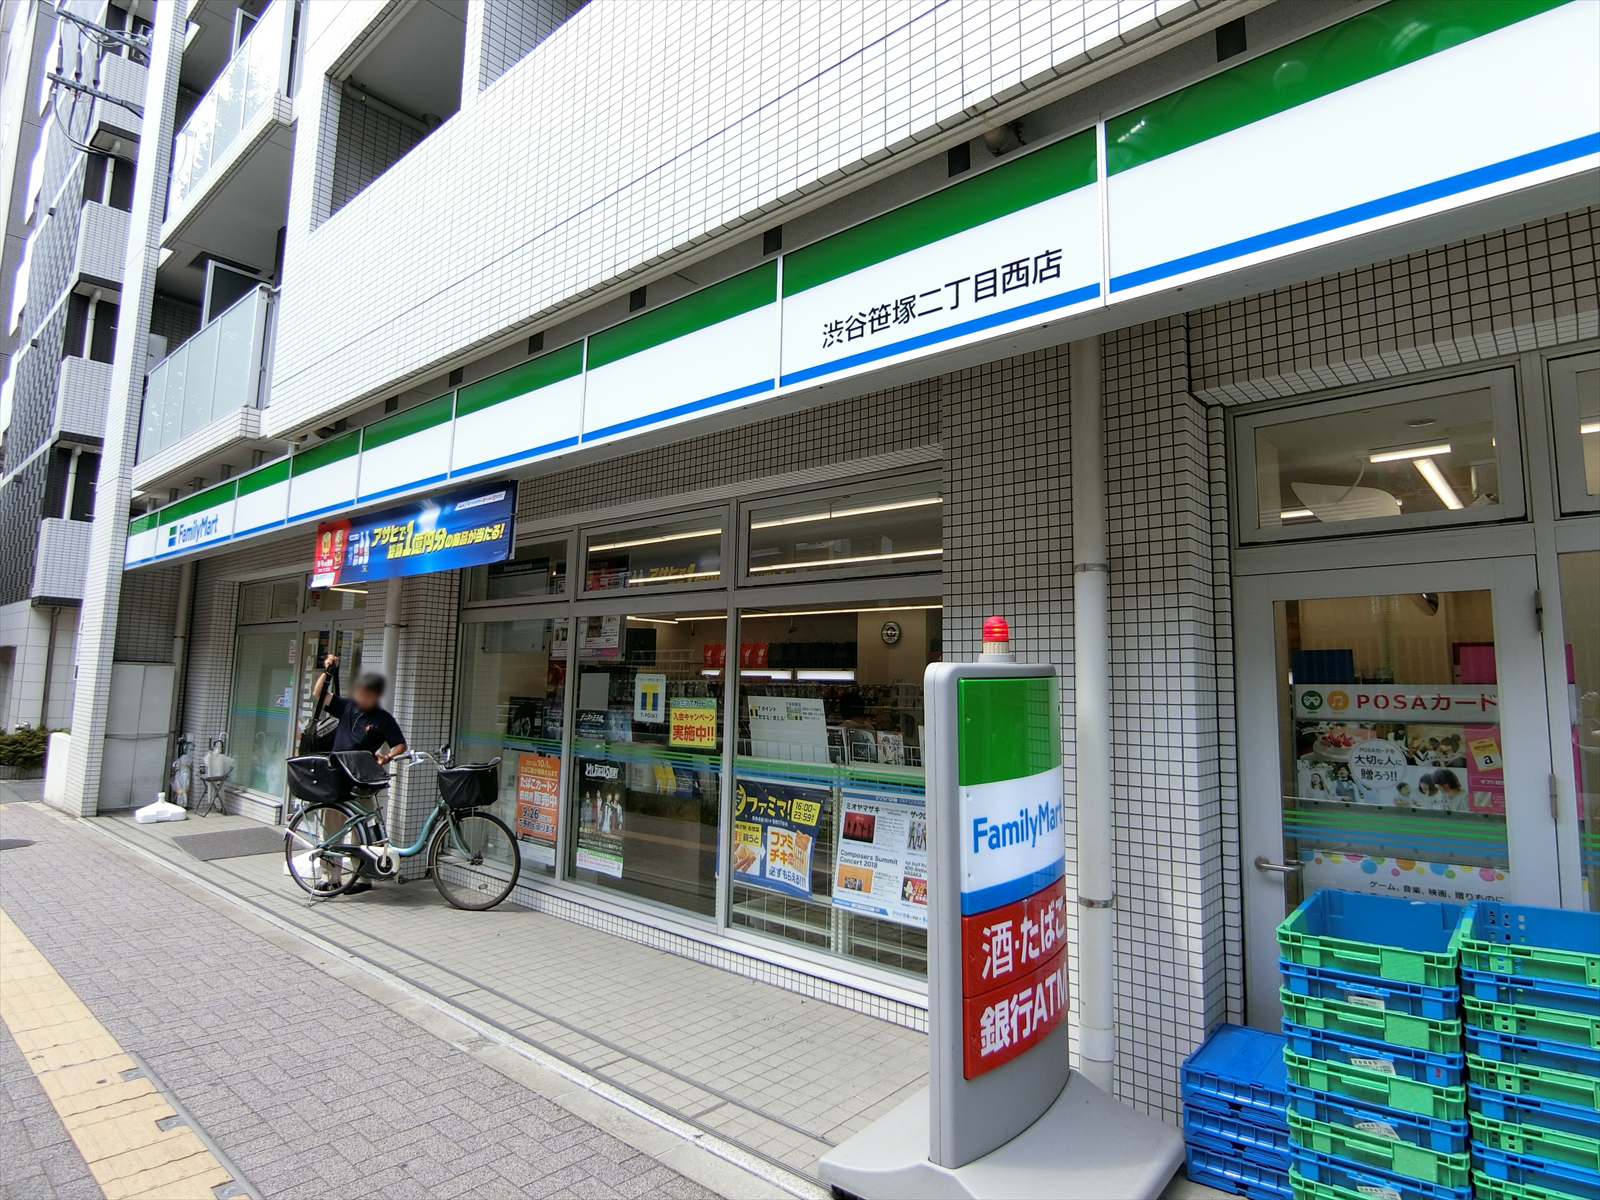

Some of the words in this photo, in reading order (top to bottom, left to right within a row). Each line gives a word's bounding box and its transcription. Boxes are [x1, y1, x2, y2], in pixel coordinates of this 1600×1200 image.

[822, 248, 1062, 349] 渋谷笹塚二丁目西店
[178, 513, 219, 544] FamilyMart
[371, 524, 408, 547] アサヒで
[503, 561, 533, 572] Information
[297, 637, 319, 734] Family
[1356, 693, 1498, 712] POSAカード
[672, 712, 715, 722] 入会キャンペーン
[672, 725, 715, 742] 実施中!!
[1473, 743, 1494, 751] amazon
[1354, 754, 1403, 766] 大切な人に
[1360, 769, 1398, 782] 贈ろう!!
[520, 777, 558, 793] たばこカートン
[747, 795, 792, 820] ファミマ!
[845, 802, 880, 814] ミオヤマザキ
[973, 797, 1063, 854] FamilyMart
[839, 856, 863, 867] Concert
[863, 860, 878, 869] 2018
[840, 849, 874, 861] Composers
[874, 853, 898, 865] Summit
[1369, 880, 1505, 902] ゲーム、音楽、映画、贈りものに
[981, 895, 1066, 980] 酒・たばこ
[979, 962, 1068, 1057] 銀行ATM
